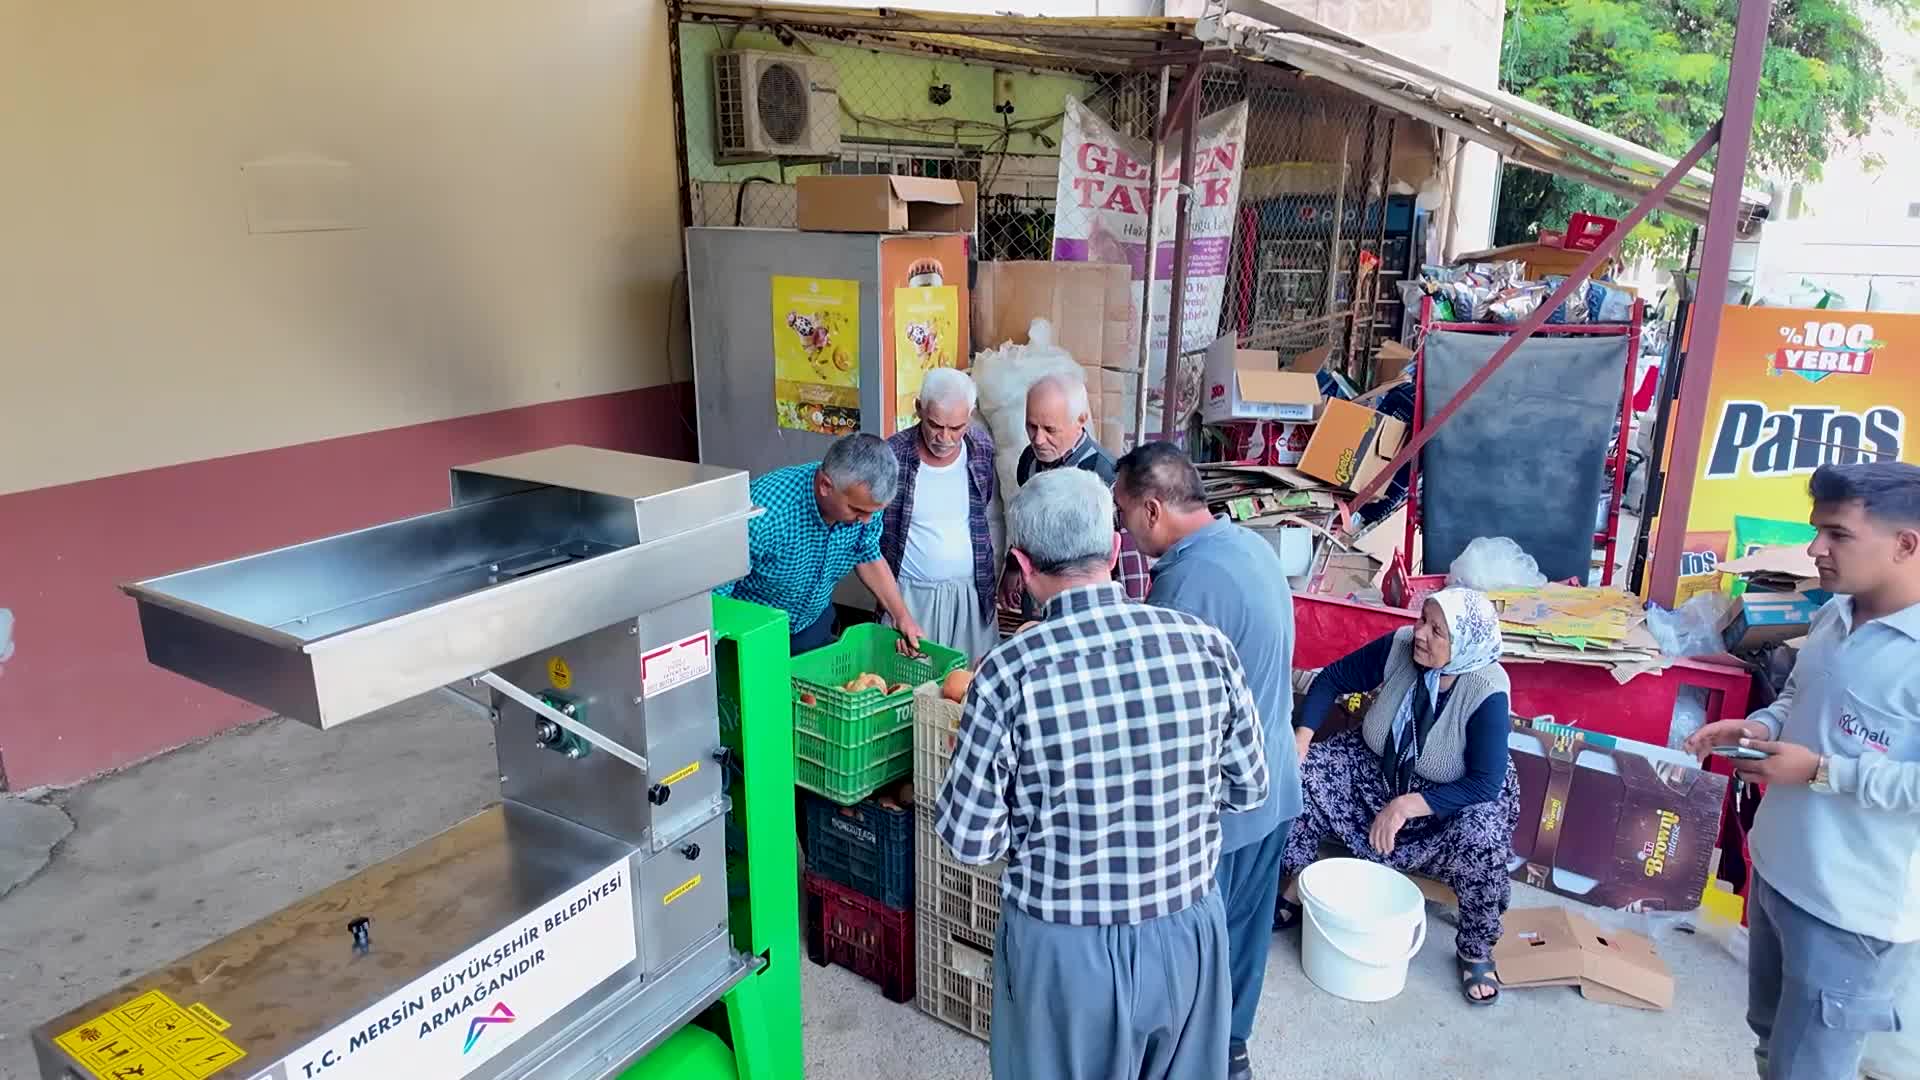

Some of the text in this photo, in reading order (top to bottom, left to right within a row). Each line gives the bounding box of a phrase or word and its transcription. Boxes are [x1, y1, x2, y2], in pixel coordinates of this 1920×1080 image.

[1072, 176, 1232, 215] TAVK
[1779, 321, 1874, 348] %100
[302, 1051, 342, 1080] T.C.
[349, 996, 425, 1053] MERSİN
[430, 926, 539, 1003] BÜYÜKŞEHİR
[544, 871, 623, 933] BELEDİYESİ
[418, 948, 546, 1040] ARMAĞANIDIR
